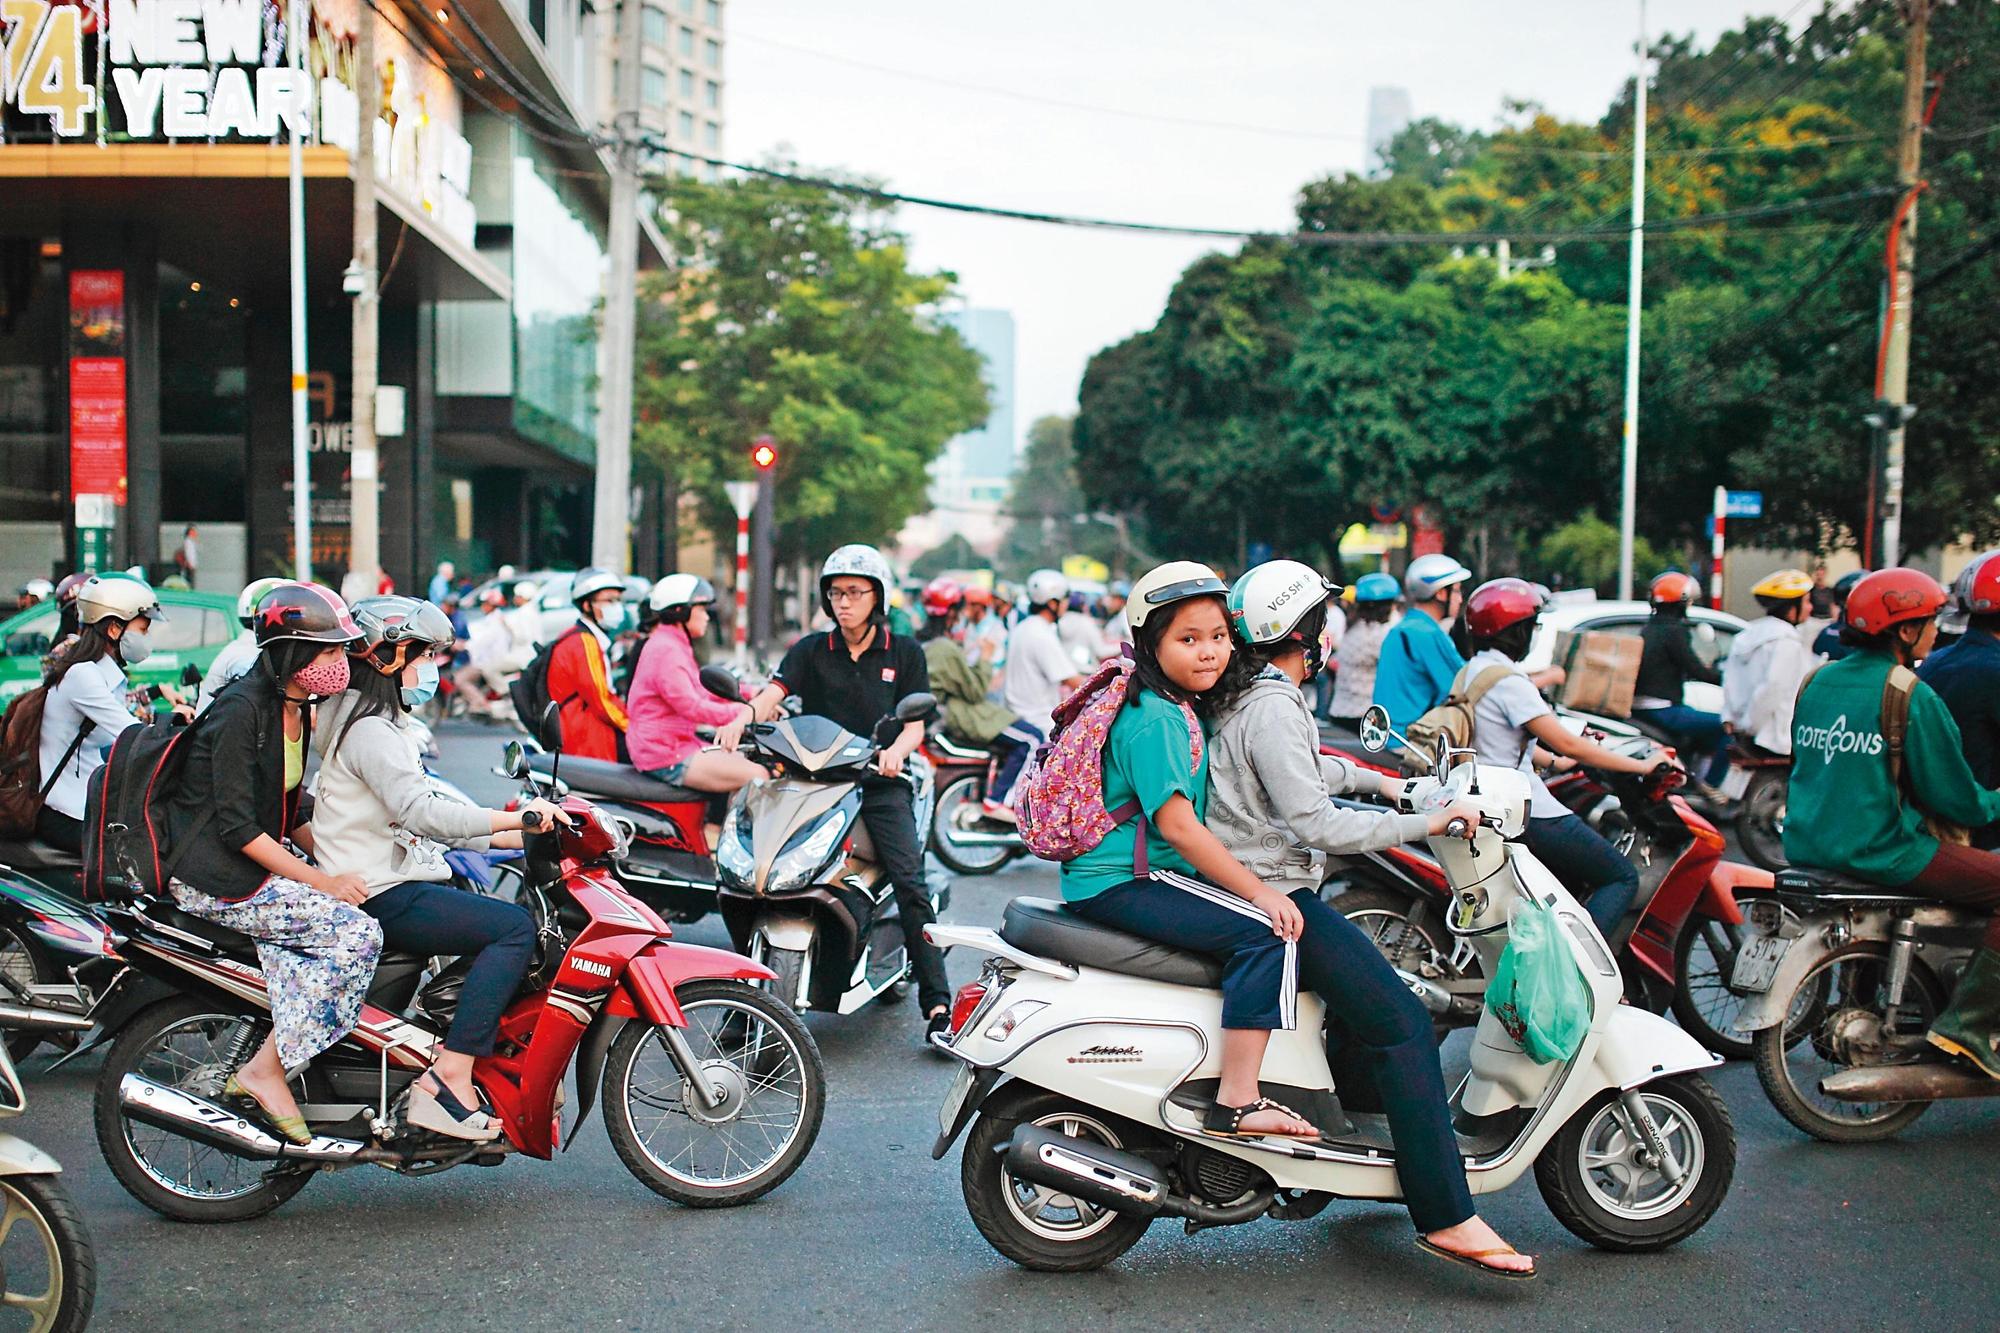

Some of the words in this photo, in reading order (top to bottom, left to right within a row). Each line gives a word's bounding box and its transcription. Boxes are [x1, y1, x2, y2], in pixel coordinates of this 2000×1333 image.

[109, 0, 263, 64] NEW
[112, 68, 312, 137] YEAR
[305, 421, 352, 453] OWE
[1267, 591, 1291, 611] VGS
[1288, 574, 1311, 596] SHP
[1782, 879, 1809, 887] HONDA
[571, 956, 612, 978] YAMAHA
[1643, 1115, 1669, 1158] DYNAMIC
